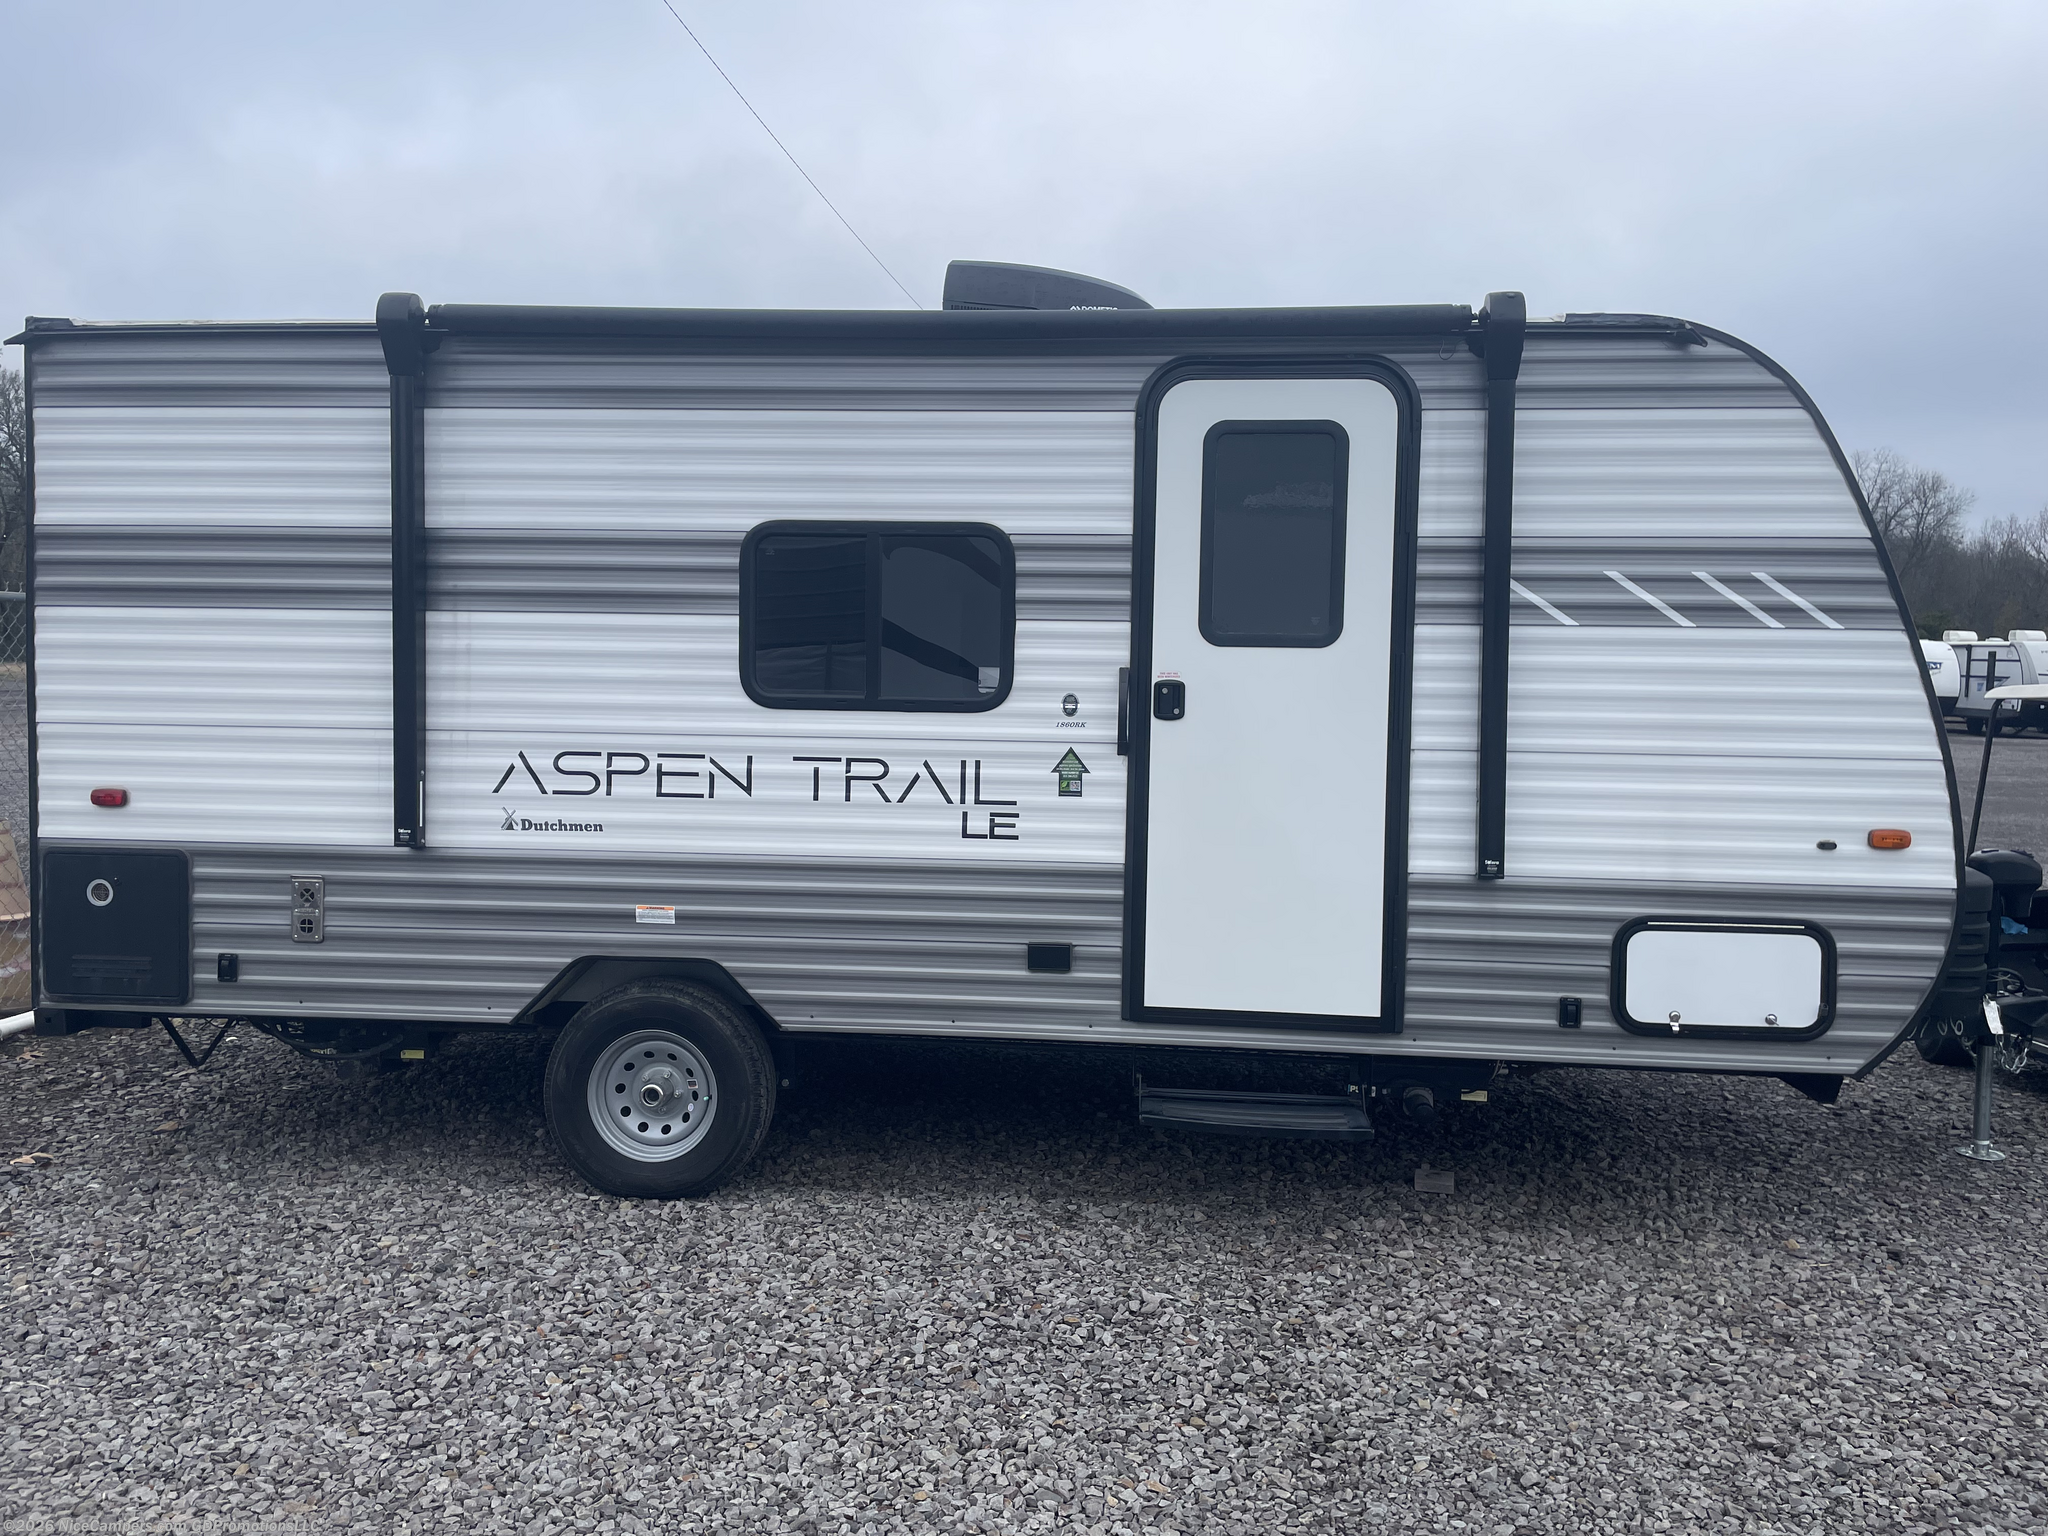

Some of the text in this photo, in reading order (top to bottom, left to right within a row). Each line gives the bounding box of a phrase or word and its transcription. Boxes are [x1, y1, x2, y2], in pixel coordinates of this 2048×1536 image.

[1056, 721, 1087, 729] 1860RK
[491, 750, 753, 798] ASPEN
[792, 756, 1017, 806] TRAIL
[520, 818, 604, 832] Dutchmen
[961, 810, 1020, 841] LE
